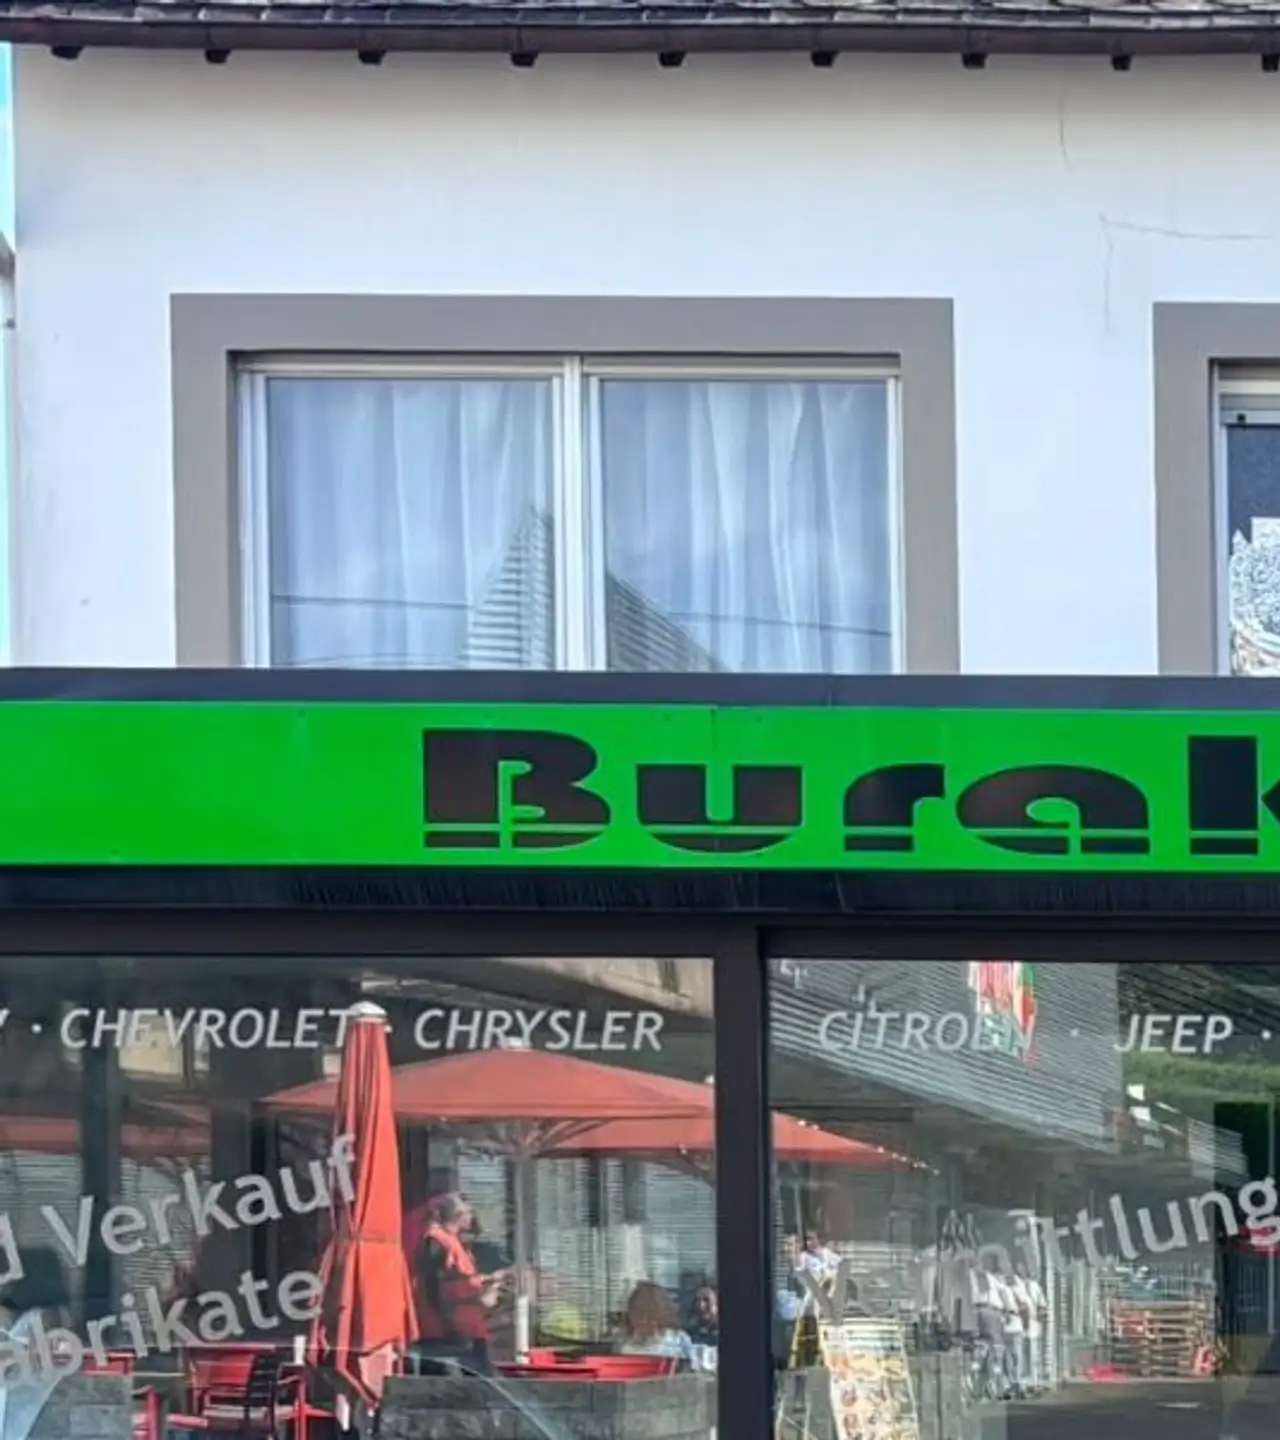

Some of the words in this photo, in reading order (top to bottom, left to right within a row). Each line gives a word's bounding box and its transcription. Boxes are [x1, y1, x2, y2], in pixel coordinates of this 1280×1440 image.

[60, 1008, 354, 1049] CHEVROLET
[413, 1008, 664, 1051] CHRYSLER
[1114, 1014, 1233, 1054] JEEP
[40, 1133, 357, 1267] Verkauf
